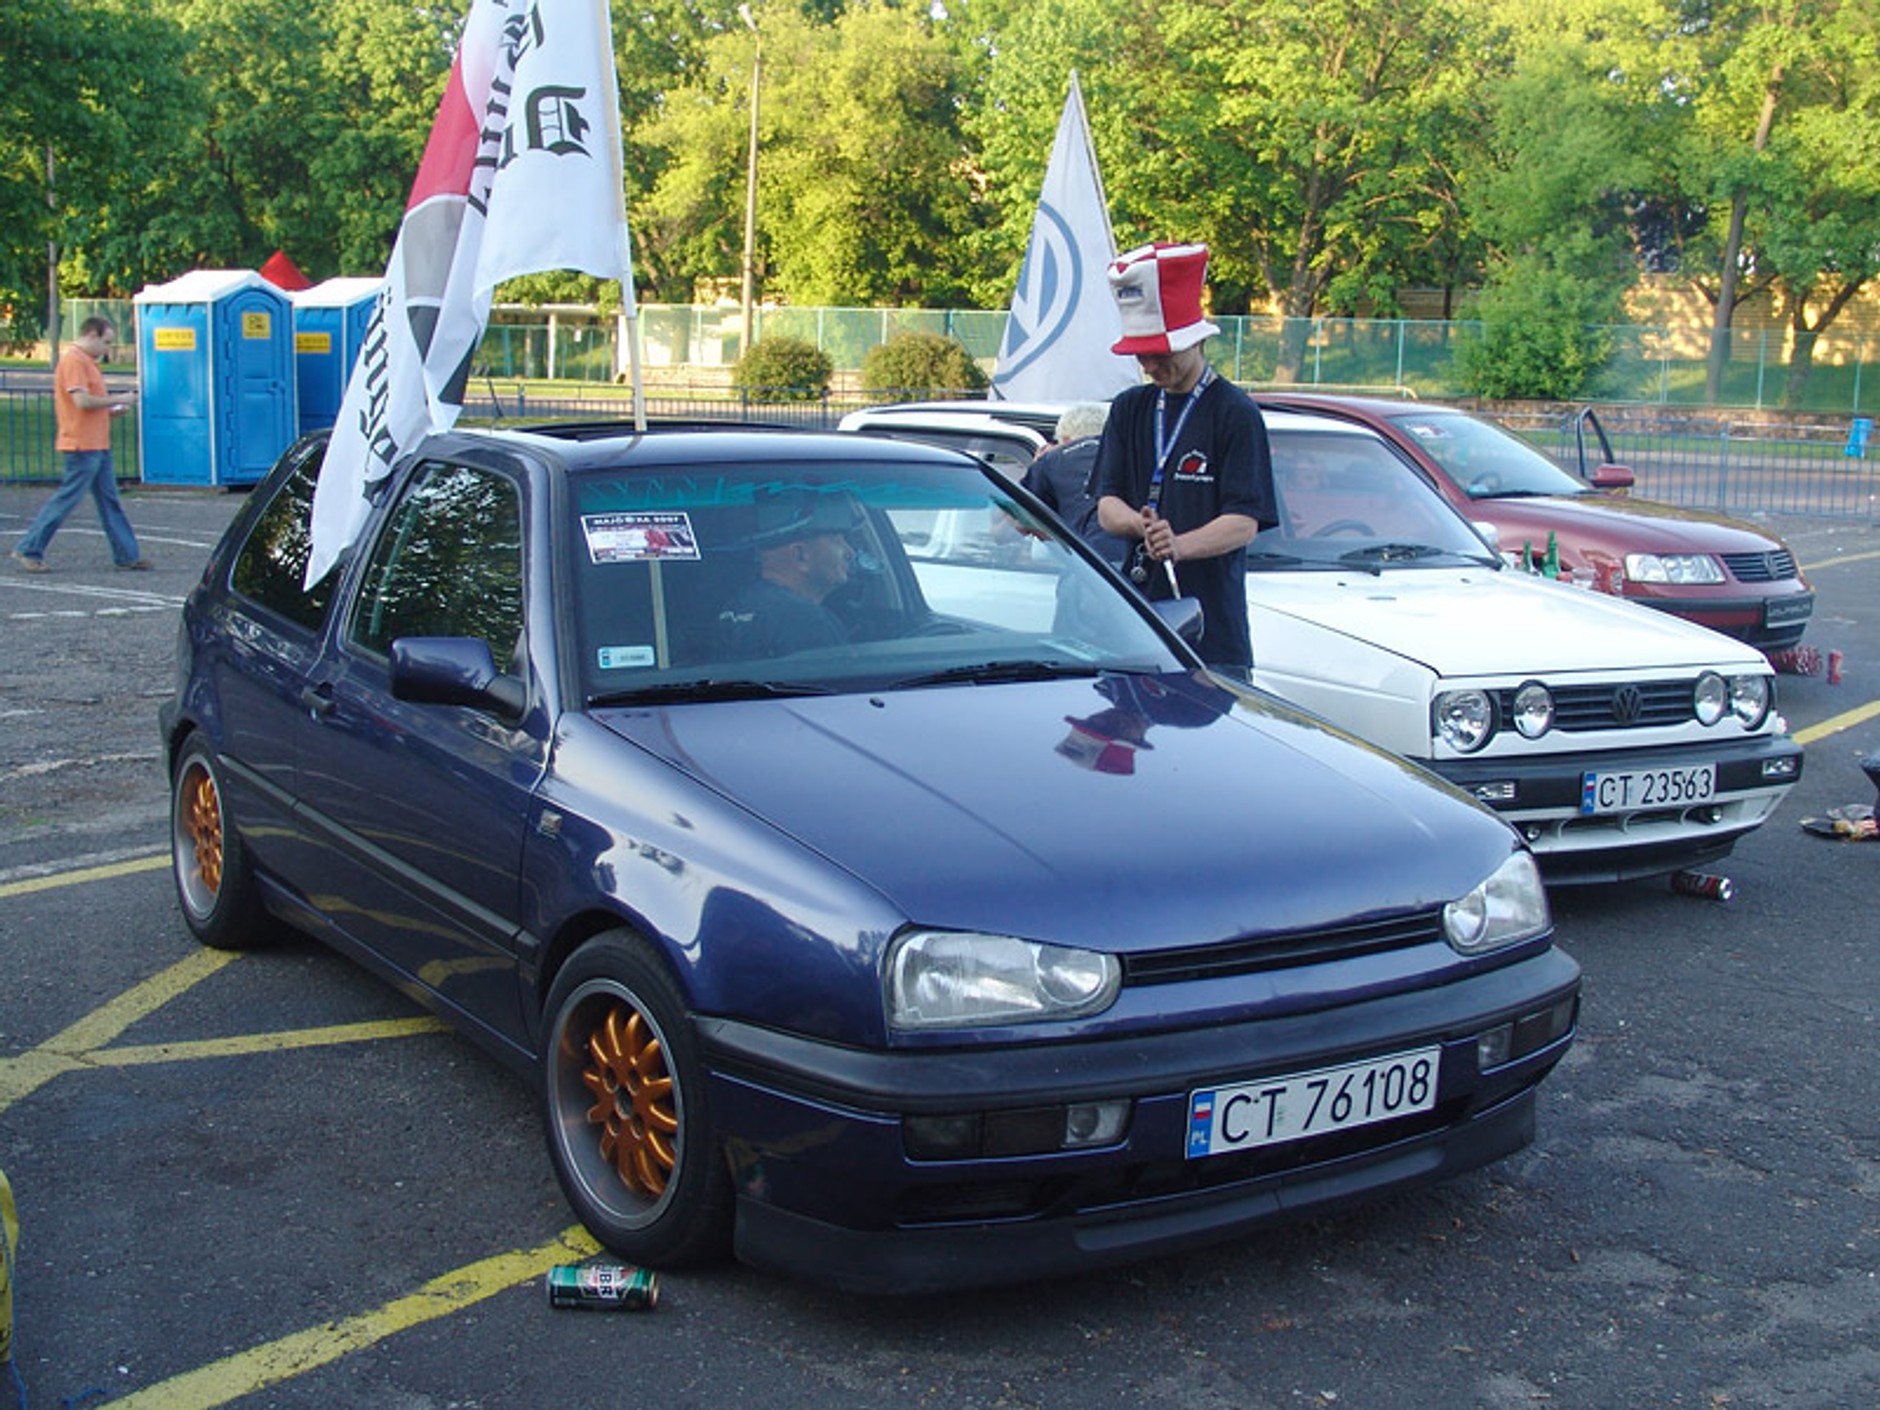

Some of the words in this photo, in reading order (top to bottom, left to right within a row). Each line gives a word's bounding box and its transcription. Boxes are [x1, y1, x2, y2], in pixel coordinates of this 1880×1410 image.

[1600, 775, 1634, 807] CT
[1641, 768, 1712, 804] 23563
[1190, 1130, 1208, 1146] PL
[1221, 1086, 1288, 1143] CT
[1302, 1059, 1431, 1130] 76108
